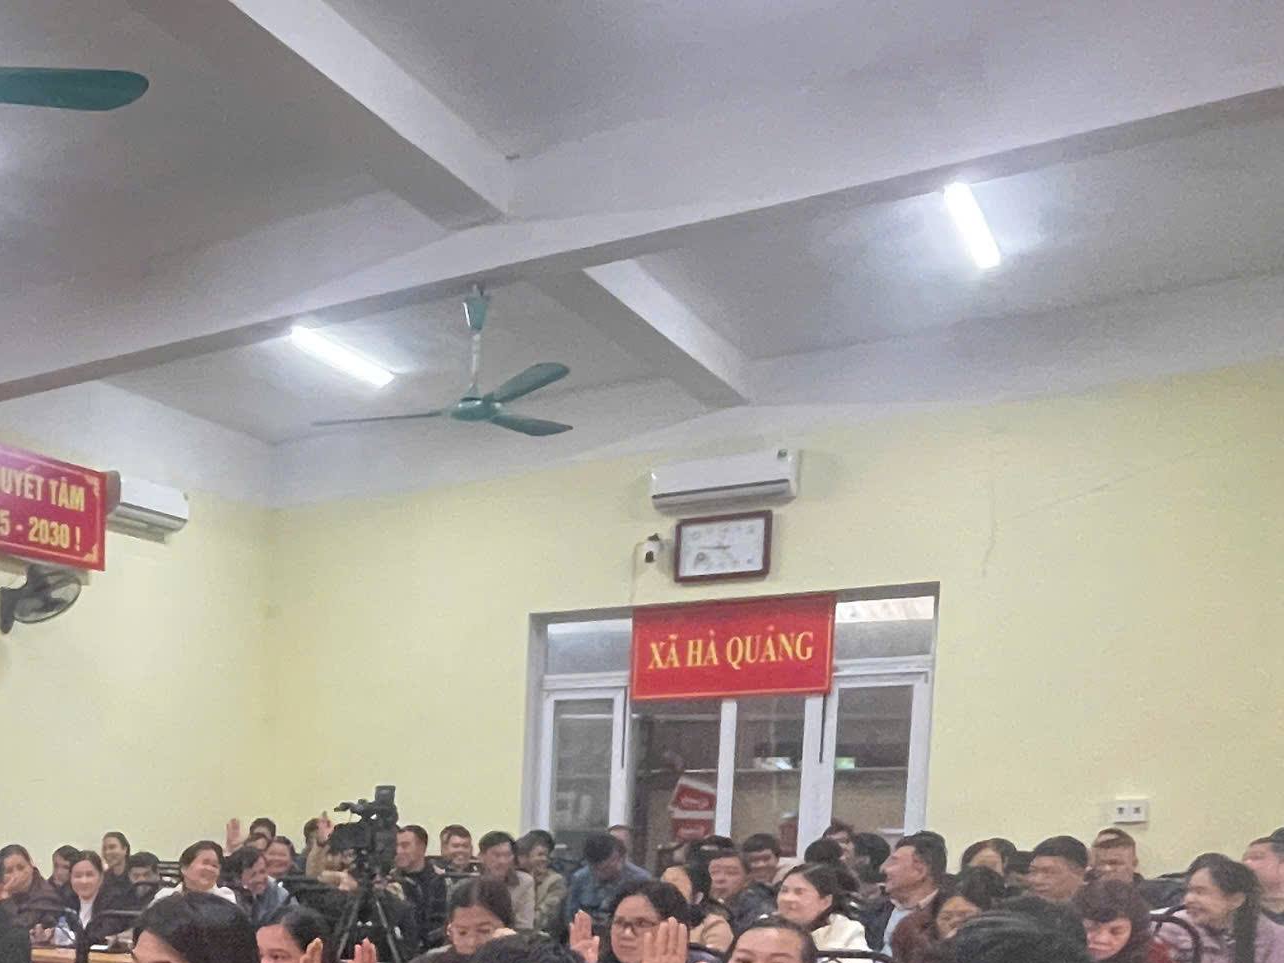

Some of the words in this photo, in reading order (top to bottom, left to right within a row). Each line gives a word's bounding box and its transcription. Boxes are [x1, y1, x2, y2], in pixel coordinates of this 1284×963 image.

[49, 476, 85, 512] TÂM
[28, 516, 70, 549] 2030
[647, 633, 680, 670] XÃ
[686, 629, 720, 667] HÀ
